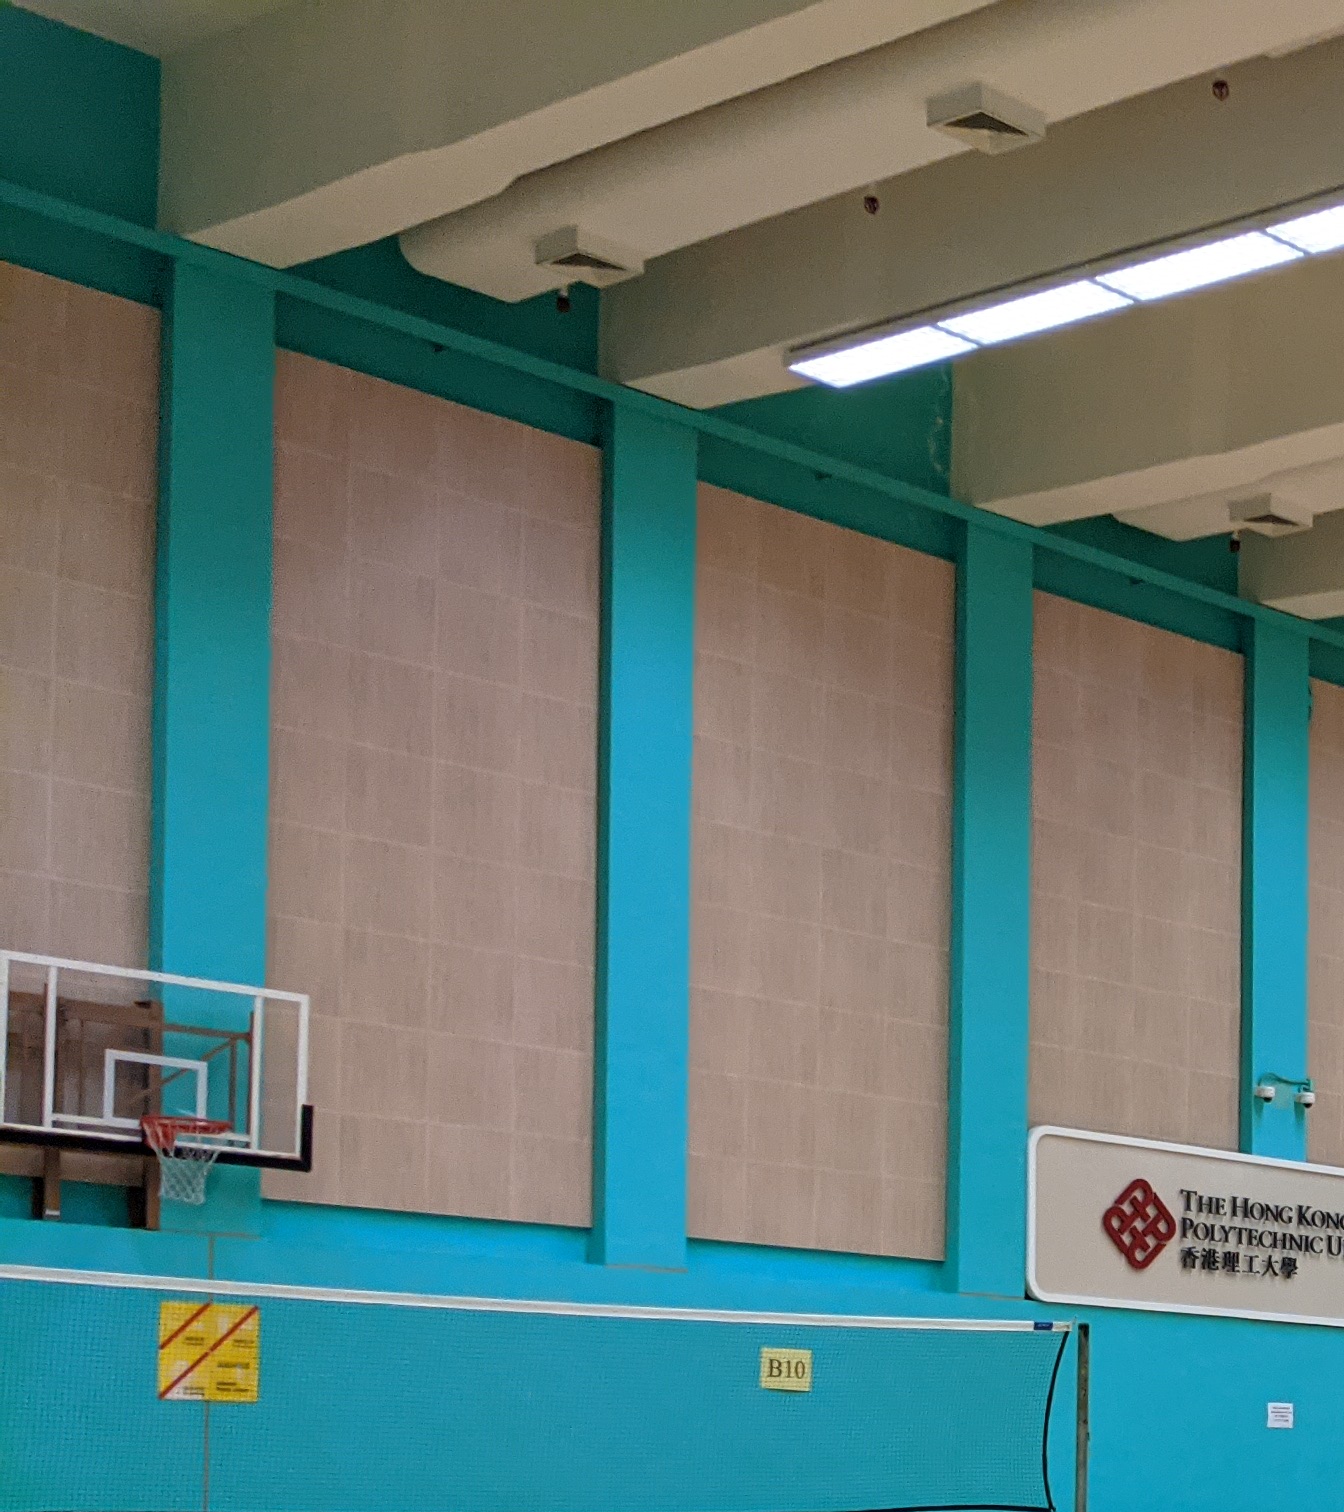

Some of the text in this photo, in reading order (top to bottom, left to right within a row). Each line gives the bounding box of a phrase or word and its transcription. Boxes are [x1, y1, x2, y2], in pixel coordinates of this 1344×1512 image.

[1180, 1188, 1227, 1216] THE
[1230, 1195, 1293, 1225] HONG
[1180, 1217, 1323, 1254] POLYTECHNIC
[1181, 1246, 1298, 1279] 香港理工大學
[768, 1358, 805, 1379] B10
